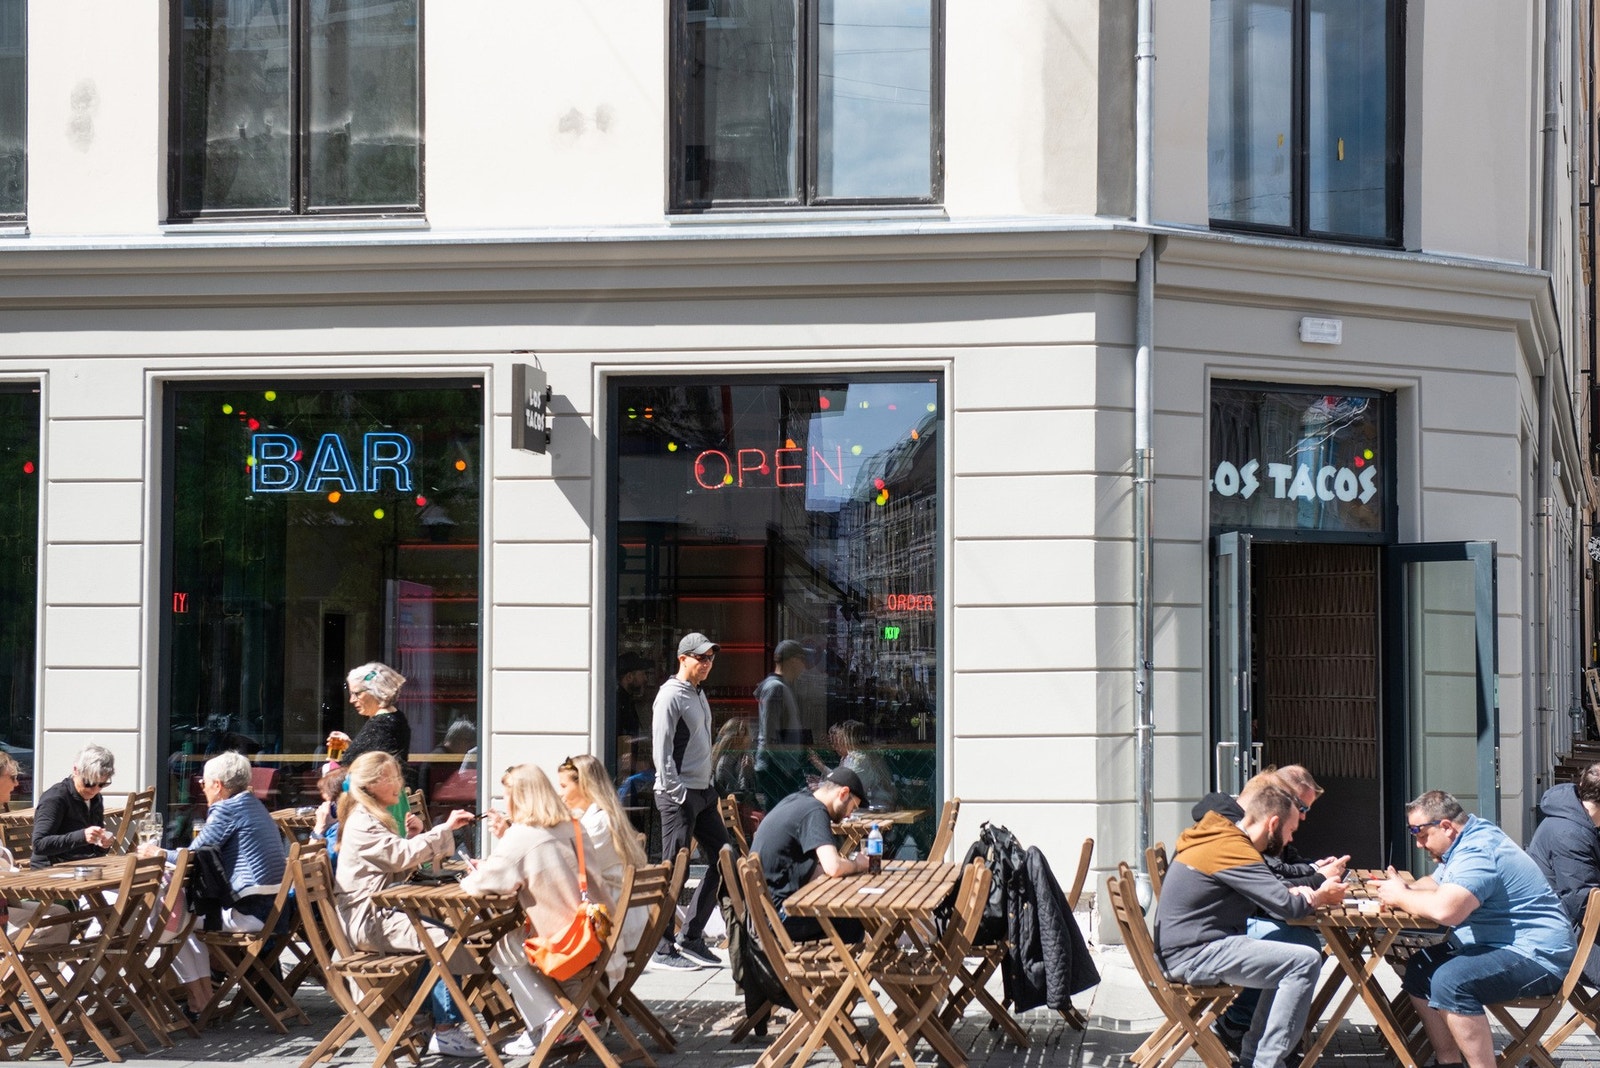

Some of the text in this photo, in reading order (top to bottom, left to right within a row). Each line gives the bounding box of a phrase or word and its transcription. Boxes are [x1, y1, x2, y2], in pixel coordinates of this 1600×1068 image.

[529, 388, 541, 409] LOS
[526, 408, 545, 432] TACOS
[252, 433, 413, 492] BAR
[694, 445, 845, 490] OPEN
[1209, 458, 1377, 505] OS TACOS
[887, 594, 933, 611] ORDER
